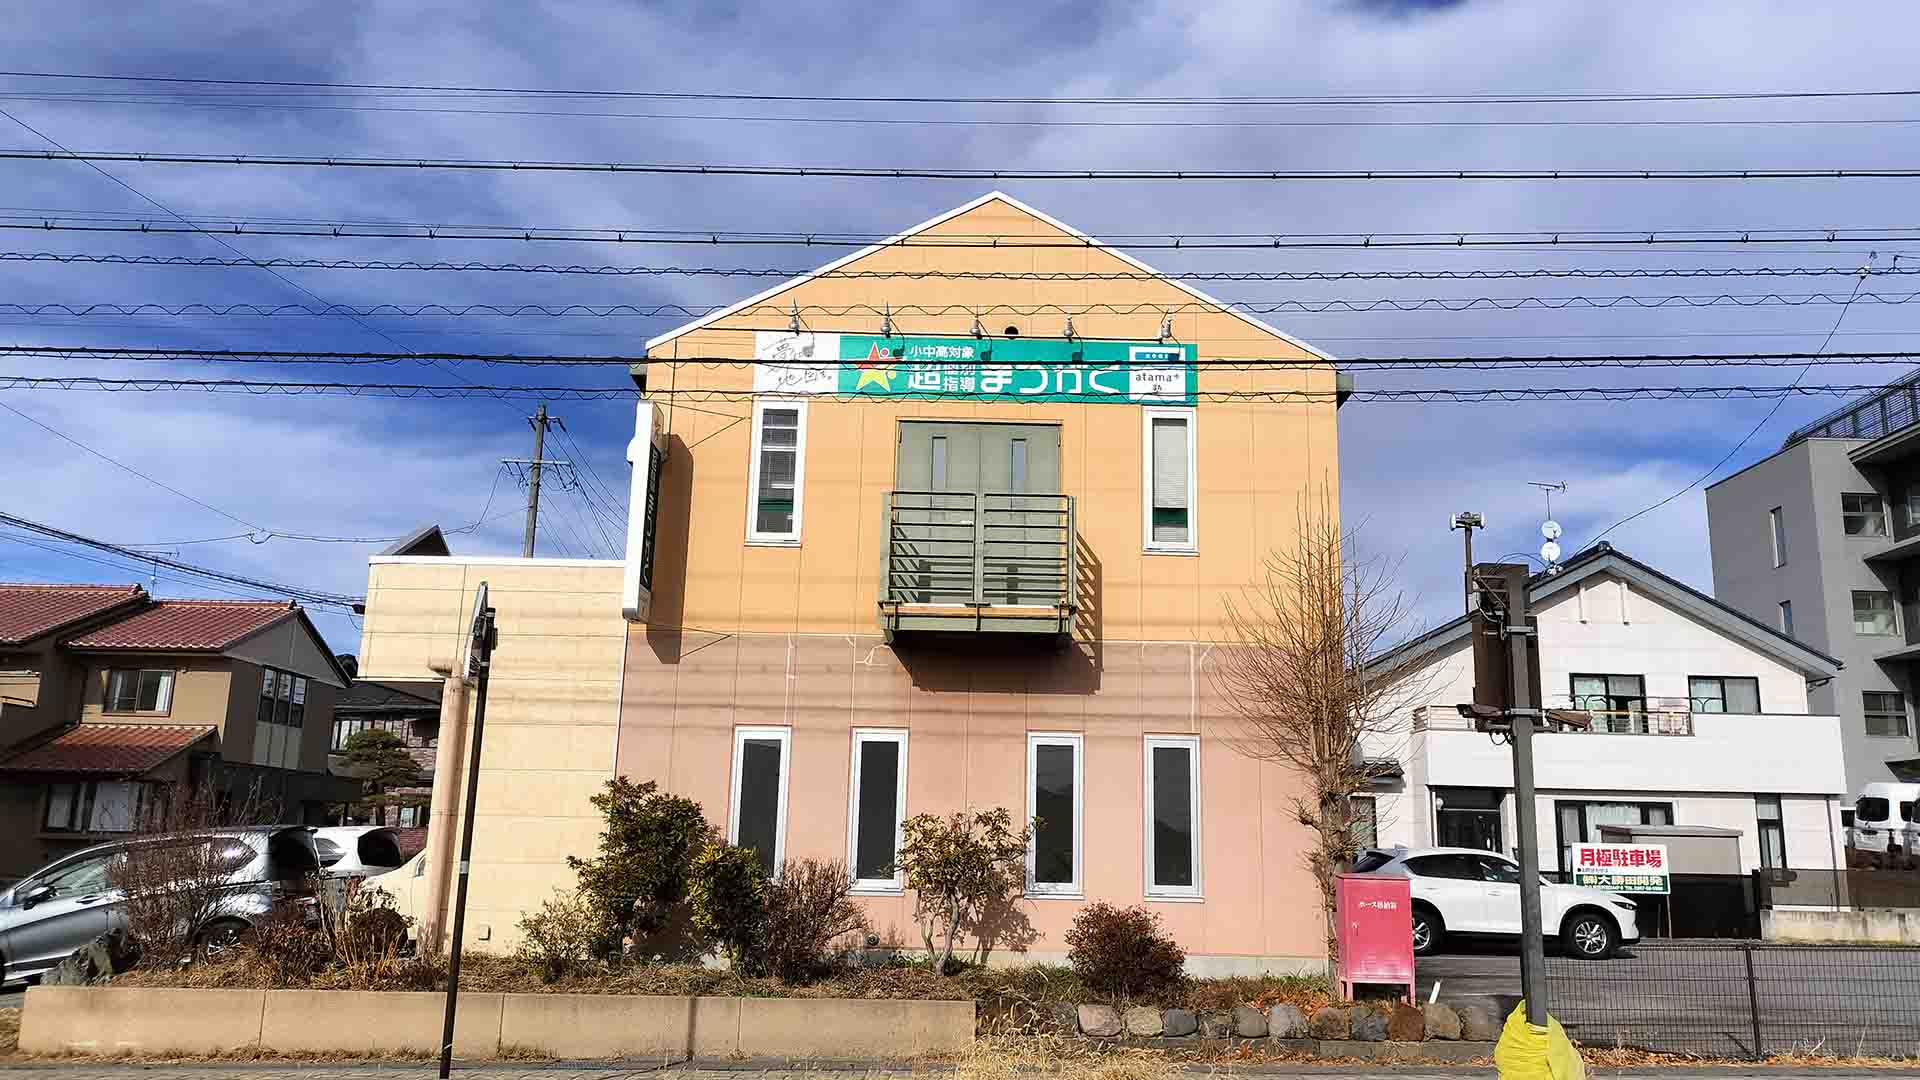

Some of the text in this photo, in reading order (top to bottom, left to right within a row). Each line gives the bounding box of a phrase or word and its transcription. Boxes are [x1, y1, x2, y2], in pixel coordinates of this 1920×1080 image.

[910, 344, 974, 359] 小中高対象
[1580, 848, 1662, 868] 月極駐車場
